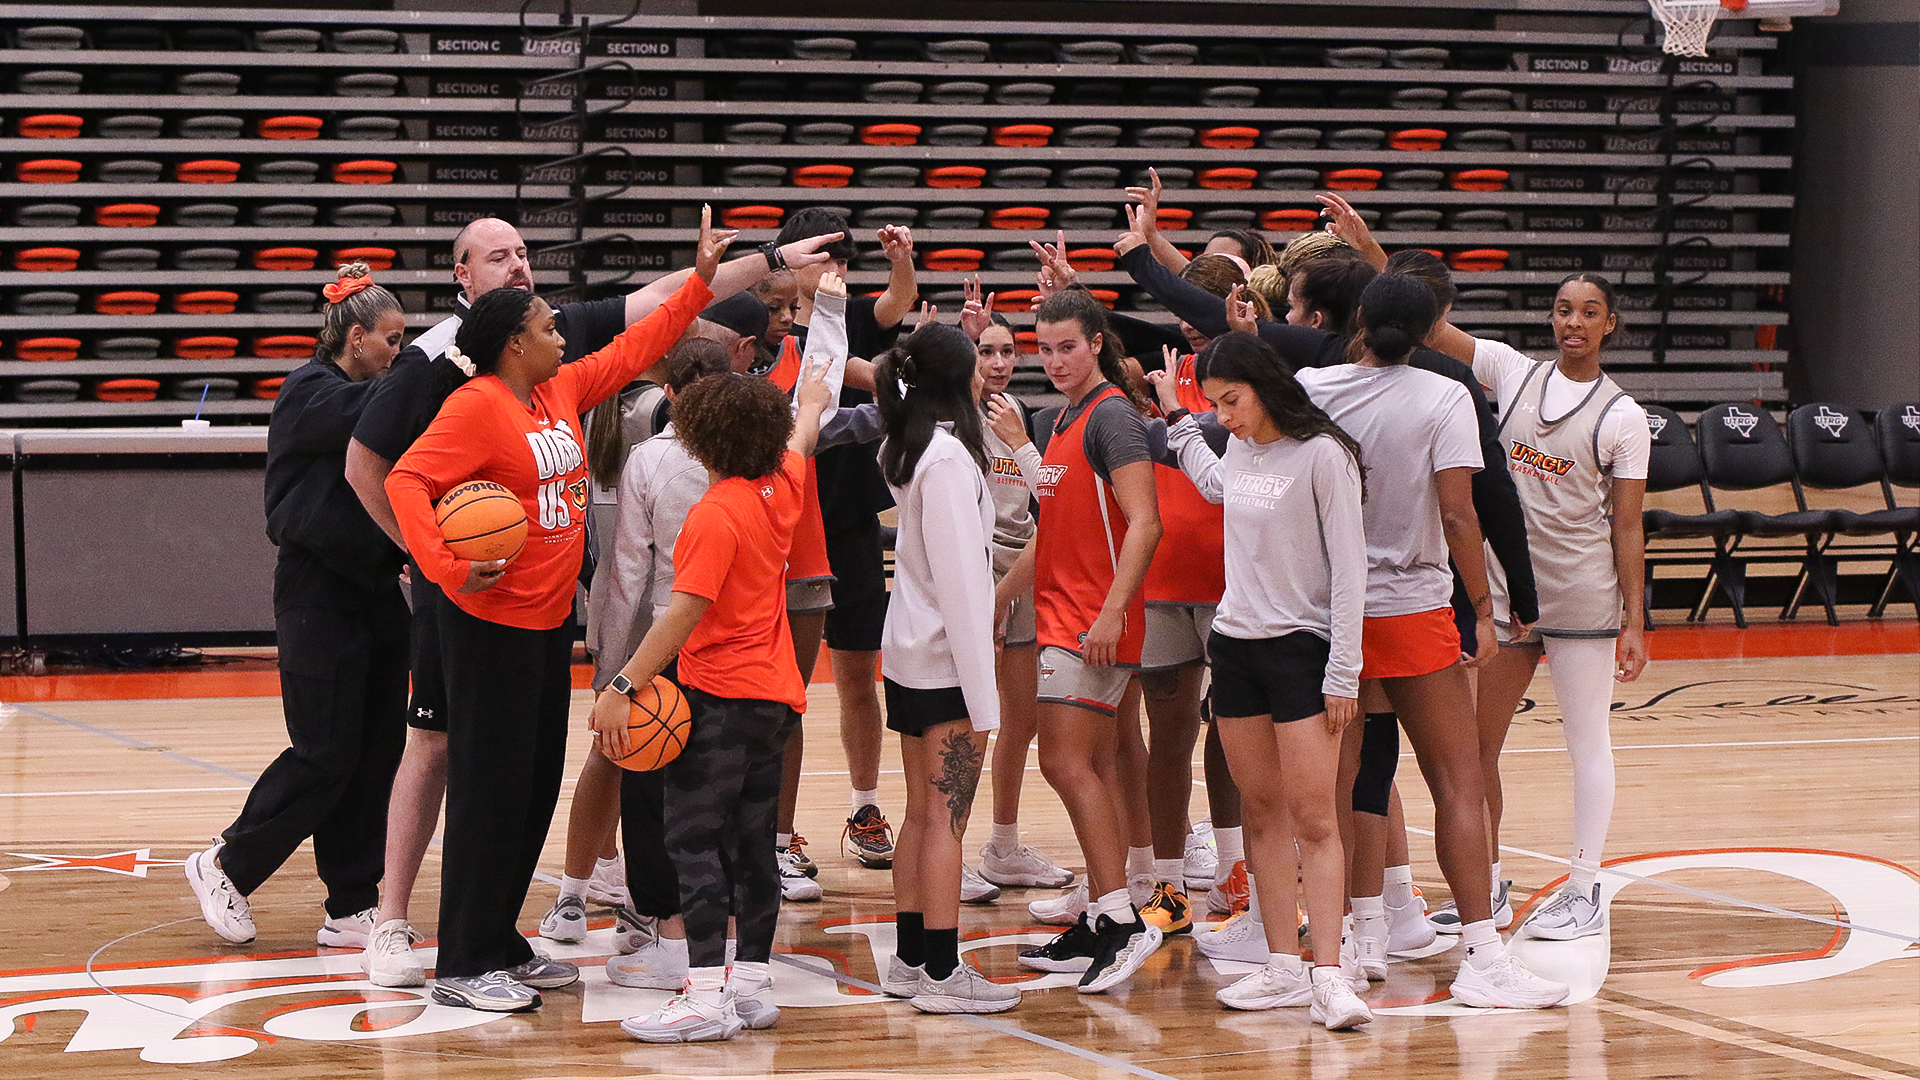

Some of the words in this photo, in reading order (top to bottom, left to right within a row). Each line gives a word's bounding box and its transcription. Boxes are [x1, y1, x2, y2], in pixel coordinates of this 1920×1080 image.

[437, 40, 488, 51] SECTION
[491, 40, 500, 51] C
[607, 43, 658, 54] SECTION
[660, 44, 669, 54] D
[1534, 59, 1578, 70] SECTION
[1580, 60, 1589, 70] D
[1679, 62, 1722, 73] SECTION
[1724, 63, 1732, 73] D
[437, 83, 487, 94] SECTION
[490, 83, 499, 94] C
[659, 87, 668, 97] D
[1532, 100, 1576, 110] SECTION
[1578, 101, 1587, 110] D
[1722, 102, 1731, 111] D
[436, 126, 486, 137] SECTION
[490, 126, 499, 136] C
[606, 128, 656, 138] SECTION
[658, 129, 667, 138] D
[1531, 139, 1575, 149] SECTION
[1577, 140, 1586, 149] D
[1722, 142, 1731, 151] D
[436, 169, 487, 180] SECTION
[490, 169, 499, 180] C
[658, 171, 667, 181] D
[1529, 178, 1574, 188] SECTION
[1576, 179, 1585, 188] D
[1720, 181, 1729, 190] D
[603, 213, 654, 223] SECTION
[656, 214, 665, 223] D
[1529, 218, 1573, 228] SECTION
[1675, 219, 1718, 229] SECTION
[656, 255, 665, 265] D
[1528, 257, 1572, 267] SECTION
[1724, 416, 1758, 426] UTRGV
[1814, 416, 1848, 426] UTRGV
[1510, 440, 1576, 476] UTRGV
[993, 457, 1023, 477] UTR
[997, 477, 1029, 488] BASKETBA
[1232, 471, 1294, 498] UTRGV
[538, 479, 571, 530] US
[1230, 495, 1276, 510] BASKETBALL
